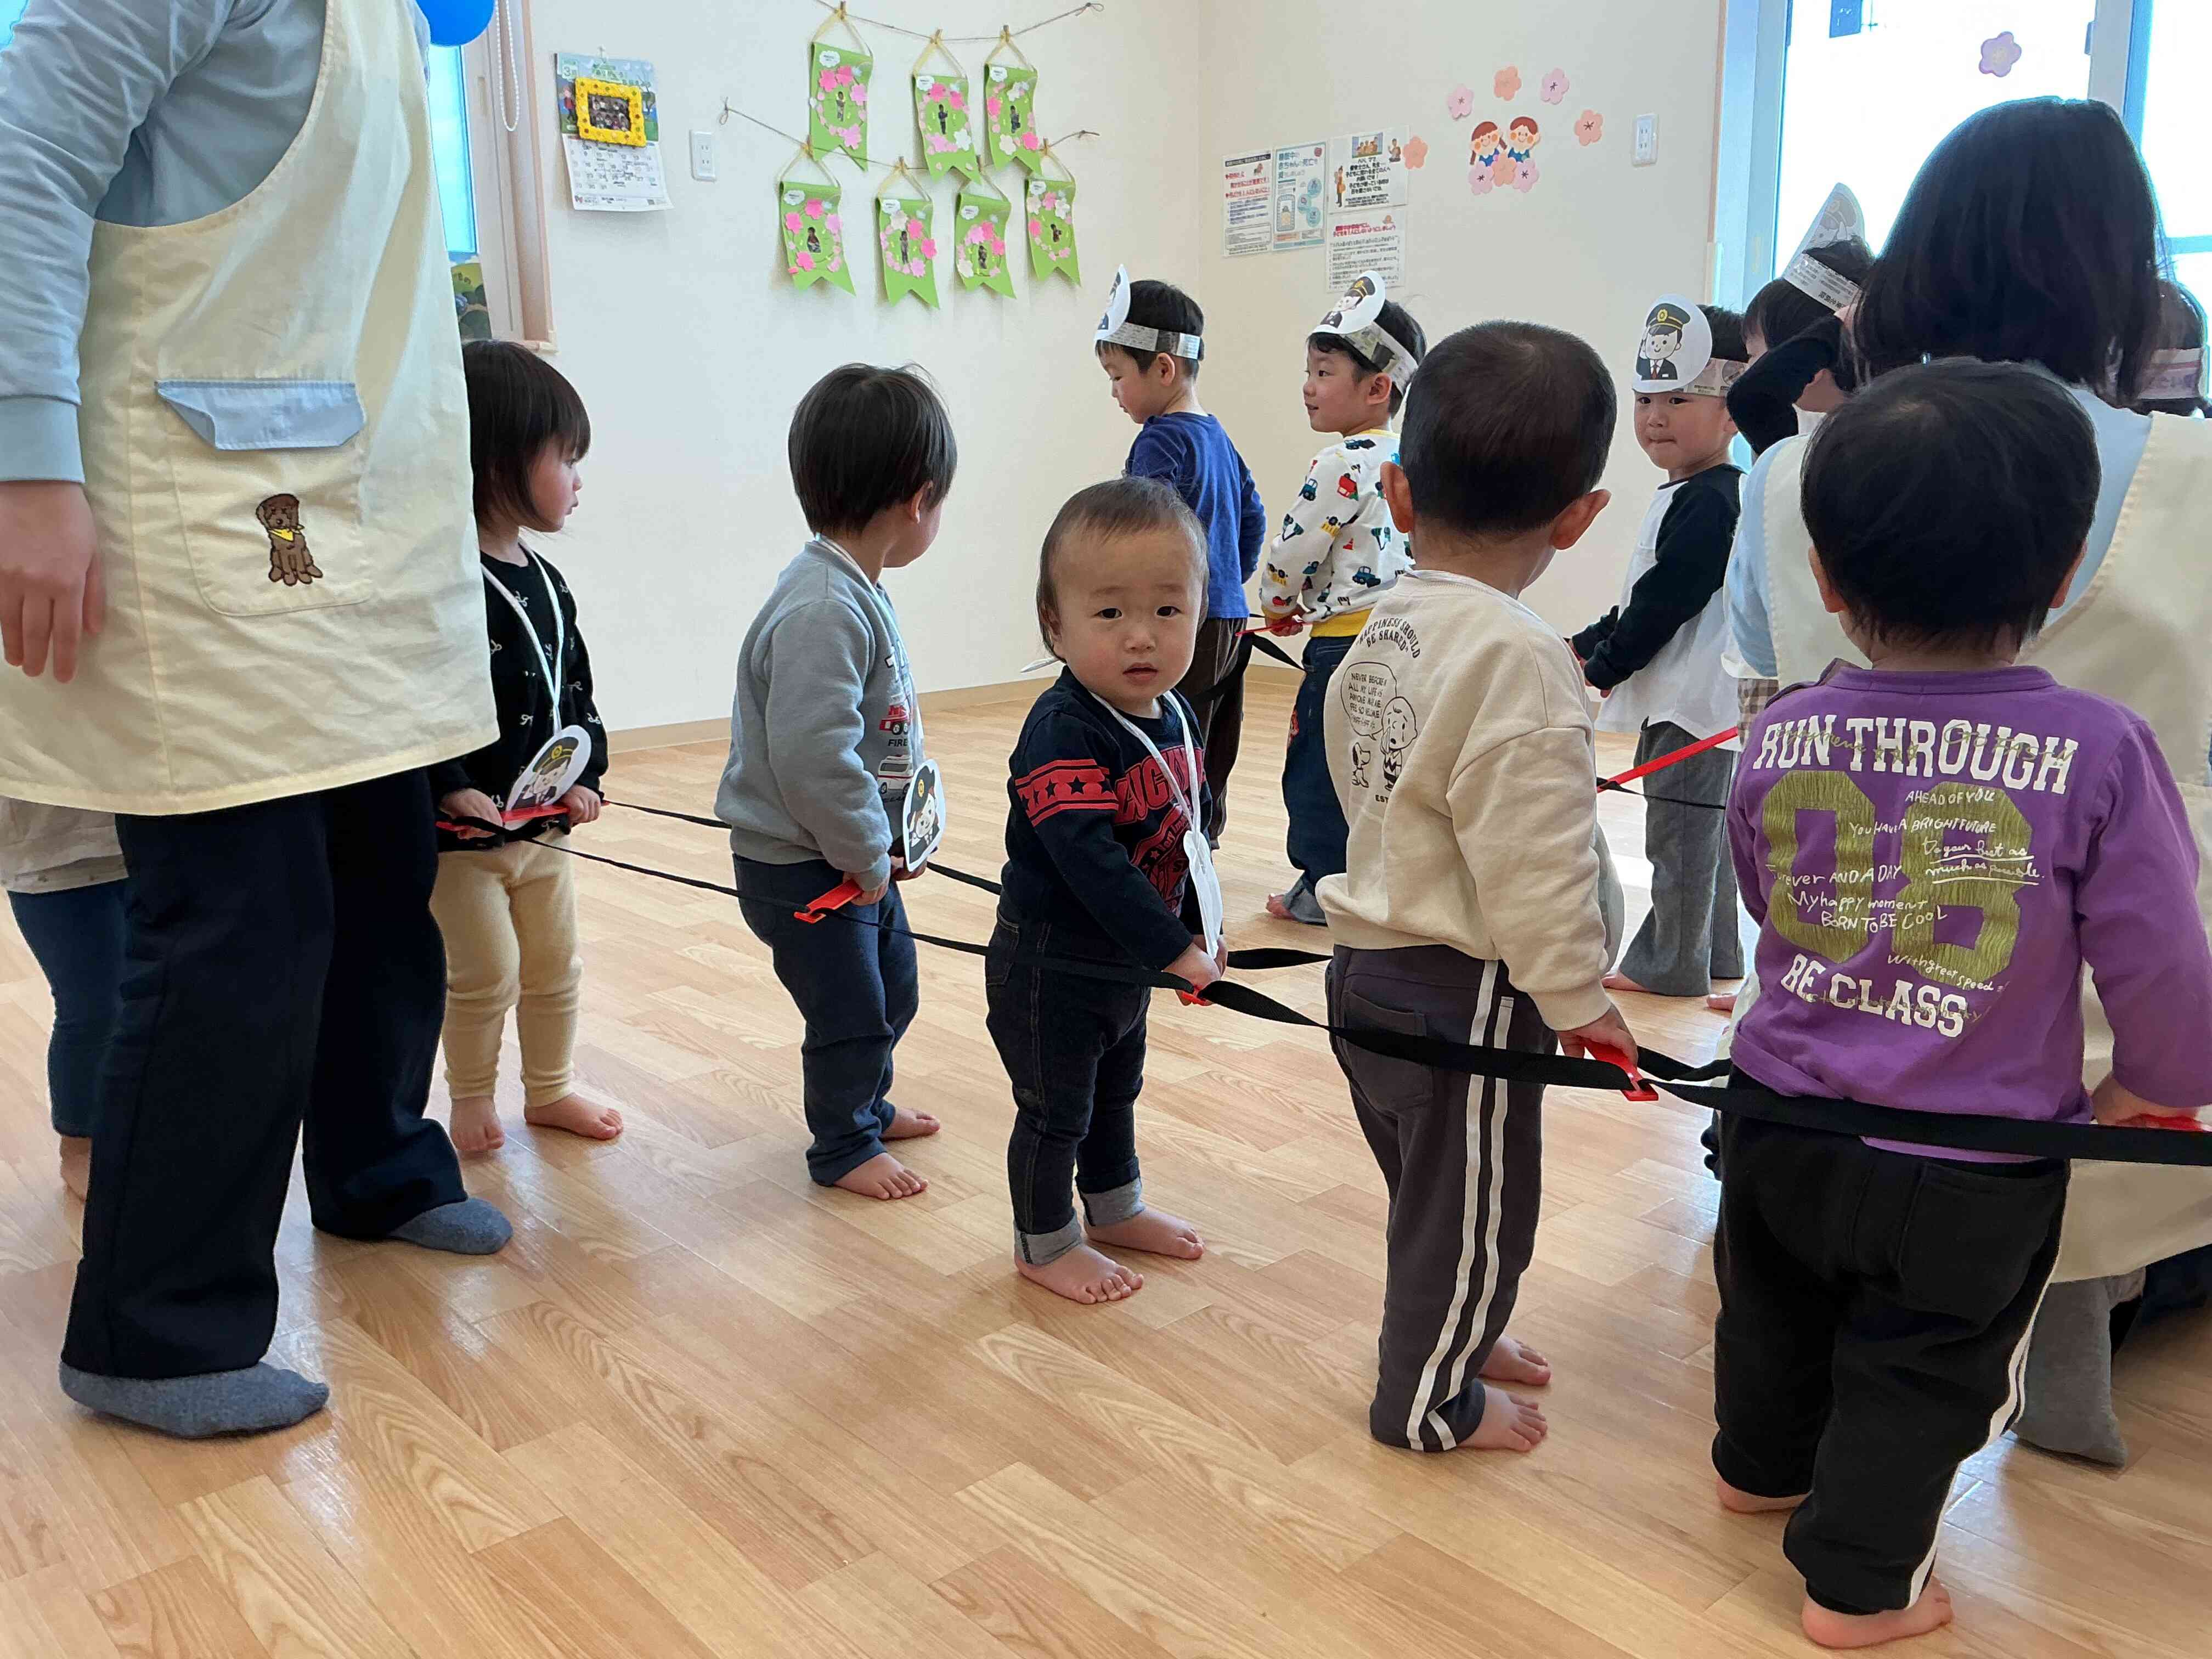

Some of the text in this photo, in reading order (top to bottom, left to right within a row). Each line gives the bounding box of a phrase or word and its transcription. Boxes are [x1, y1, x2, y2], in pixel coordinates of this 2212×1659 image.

[1366, 633, 1376, 647] BE
[1400, 621, 1420, 658] SHOULD
[1348, 682, 1358, 692] ALL
[1753, 714, 2078, 794] RUN THROUGH
[1905, 788, 1995, 805] AHEAD OF YOU
[1899, 819, 1907, 830] A
[1911, 817, 1958, 833] BRIGHT
[1958, 818, 1997, 834] FUTURE
[1922, 837, 1941, 855] Do
[1943, 844, 1971, 857] your
[1829, 870, 1857, 884] AND
[1860, 868, 1874, 882] A
[1878, 865, 1902, 882] DAY
[1926, 859, 1972, 876] much
[1787, 890, 1819, 912] My
[1880, 913, 1897, 928] BE
[1780, 953, 1966, 1037] BE CLASS
